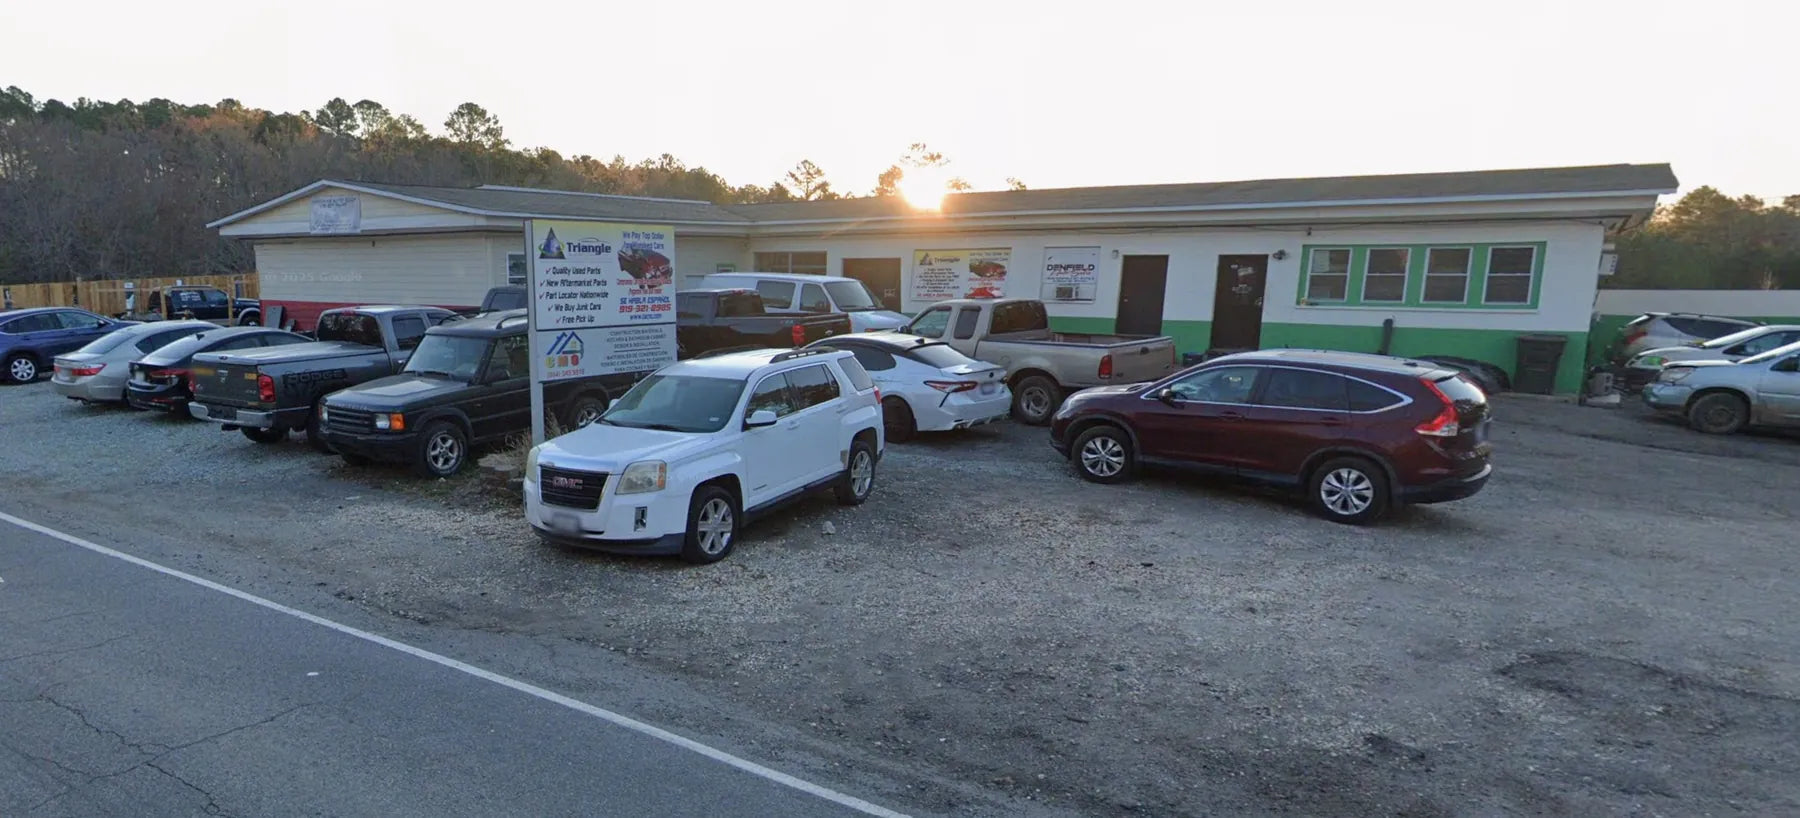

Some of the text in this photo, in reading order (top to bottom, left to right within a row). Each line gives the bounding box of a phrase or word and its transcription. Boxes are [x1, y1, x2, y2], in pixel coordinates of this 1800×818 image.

[631, 231, 640, 240] Pay
[642, 231, 650, 240] Top
[567, 242, 611, 255] Triangle
[552, 266, 601, 275] Quality Used Parts
[560, 279, 592, 287] Aftermarket
[558, 291, 578, 299] Locator
[564, 303, 575, 312] Buy
[576, 303, 588, 311] Junk
[562, 315, 574, 323] Free
[588, 315, 594, 323] Up
[552, 476, 583, 489] GMC
